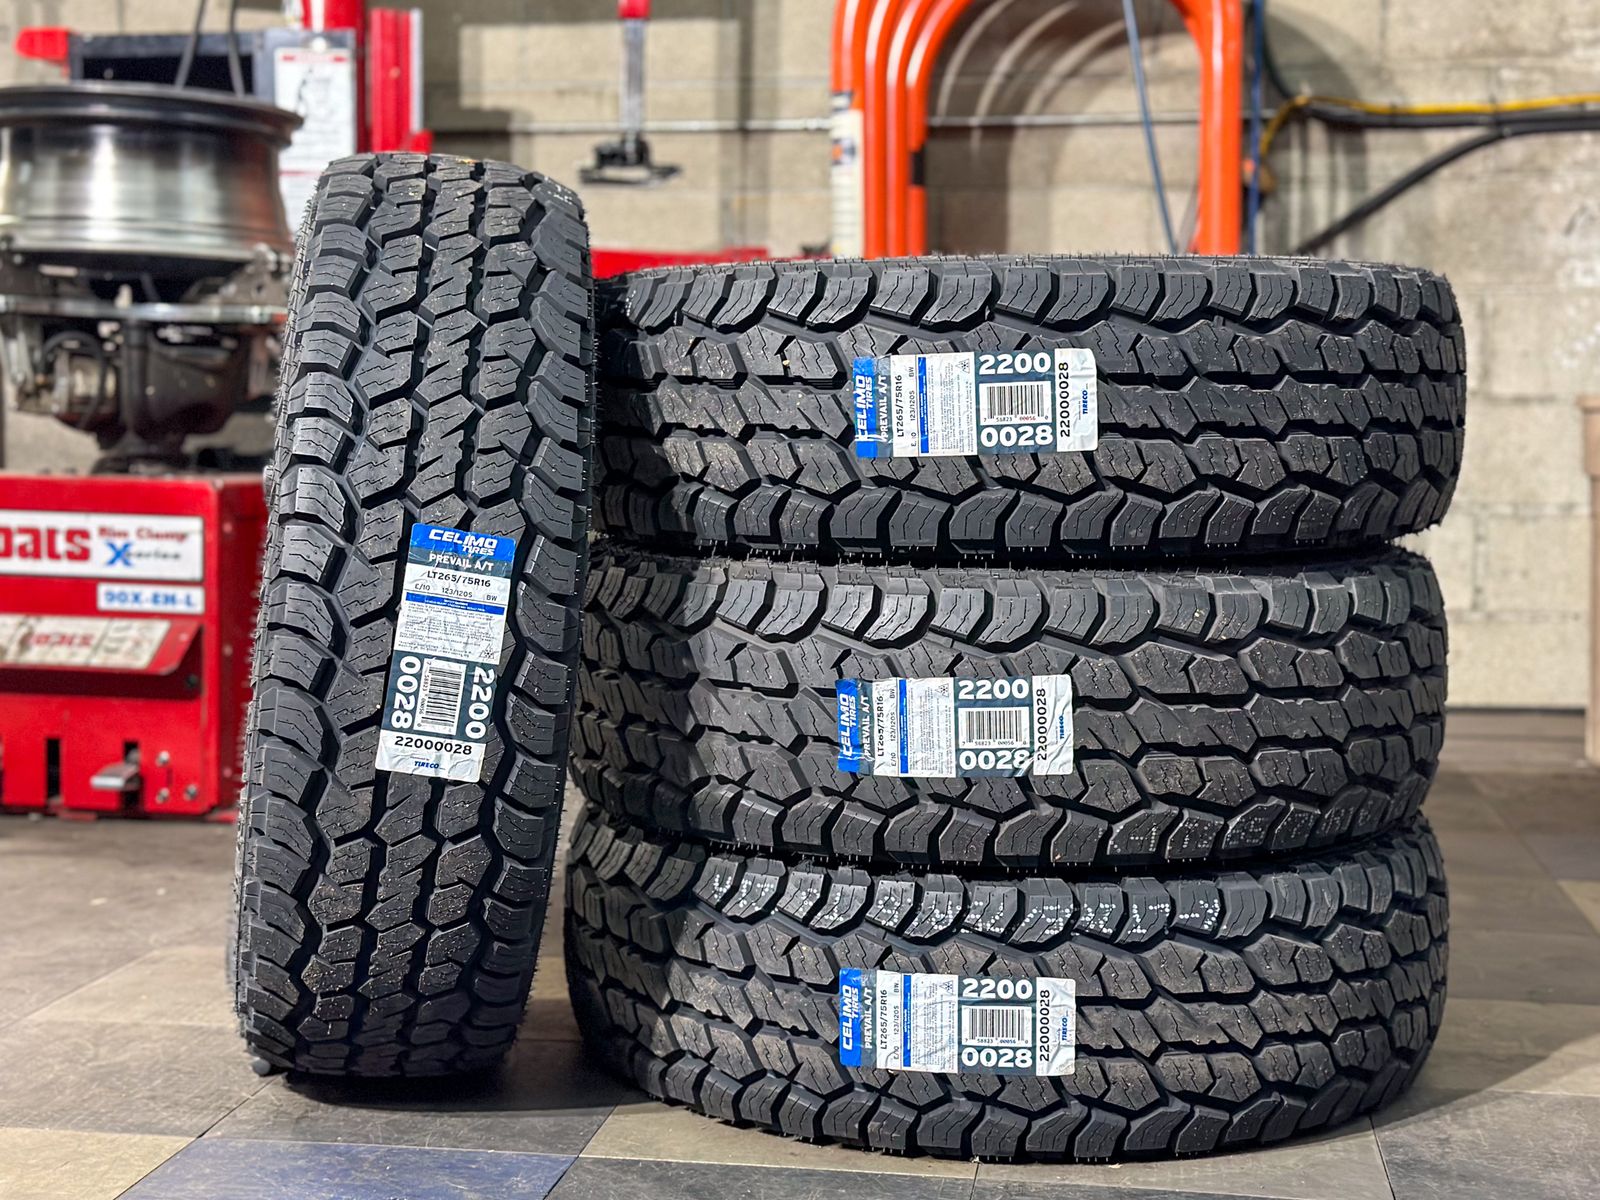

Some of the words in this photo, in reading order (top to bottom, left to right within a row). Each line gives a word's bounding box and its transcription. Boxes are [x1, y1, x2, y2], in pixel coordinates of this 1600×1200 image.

[909, 366, 914, 378] BW
[979, 352, 1051, 375] 2200
[865, 376, 873, 409] TIRES
[895, 374, 904, 438] LT265/75R16
[909, 390, 917, 421] 123/120S
[1059, 362, 1070, 437] 22000028
[879, 396, 889, 439] PREVAIL
[980, 425, 1053, 447] 0028
[428, 528, 498, 549] CELIMO
[462, 545, 495, 556] TIRES
[429, 553, 472, 569] PREVAIL
[426, 570, 491, 588] LT265/75R16
[441, 587, 473, 598] 123/120S
[391, 655, 421, 729] 0028
[465, 666, 495, 739] 2200
[889, 688, 896, 699] BW
[958, 678, 1029, 700] 2200
[849, 695, 857, 727] TIRES
[1036, 688, 1047, 760] 22000028
[862, 715, 872, 757] PREVAIL
[876, 695, 884, 757] LT265/75R16
[394, 735, 472, 755] 22000028
[414, 760, 440, 769] TIRECO
[959, 749, 1030, 770] 0028
[893, 982, 900, 993] BW
[962, 978, 1033, 1000] 2200
[851, 987, 859, 1019] TIRES
[842, 984, 853, 1050] CELIMO
[864, 1006, 873, 1049] PREVAIL
[880, 989, 888, 1050] LT265/75R16
[1040, 989, 1050, 1063] 22000028
[961, 1047, 1033, 1068] 0028
